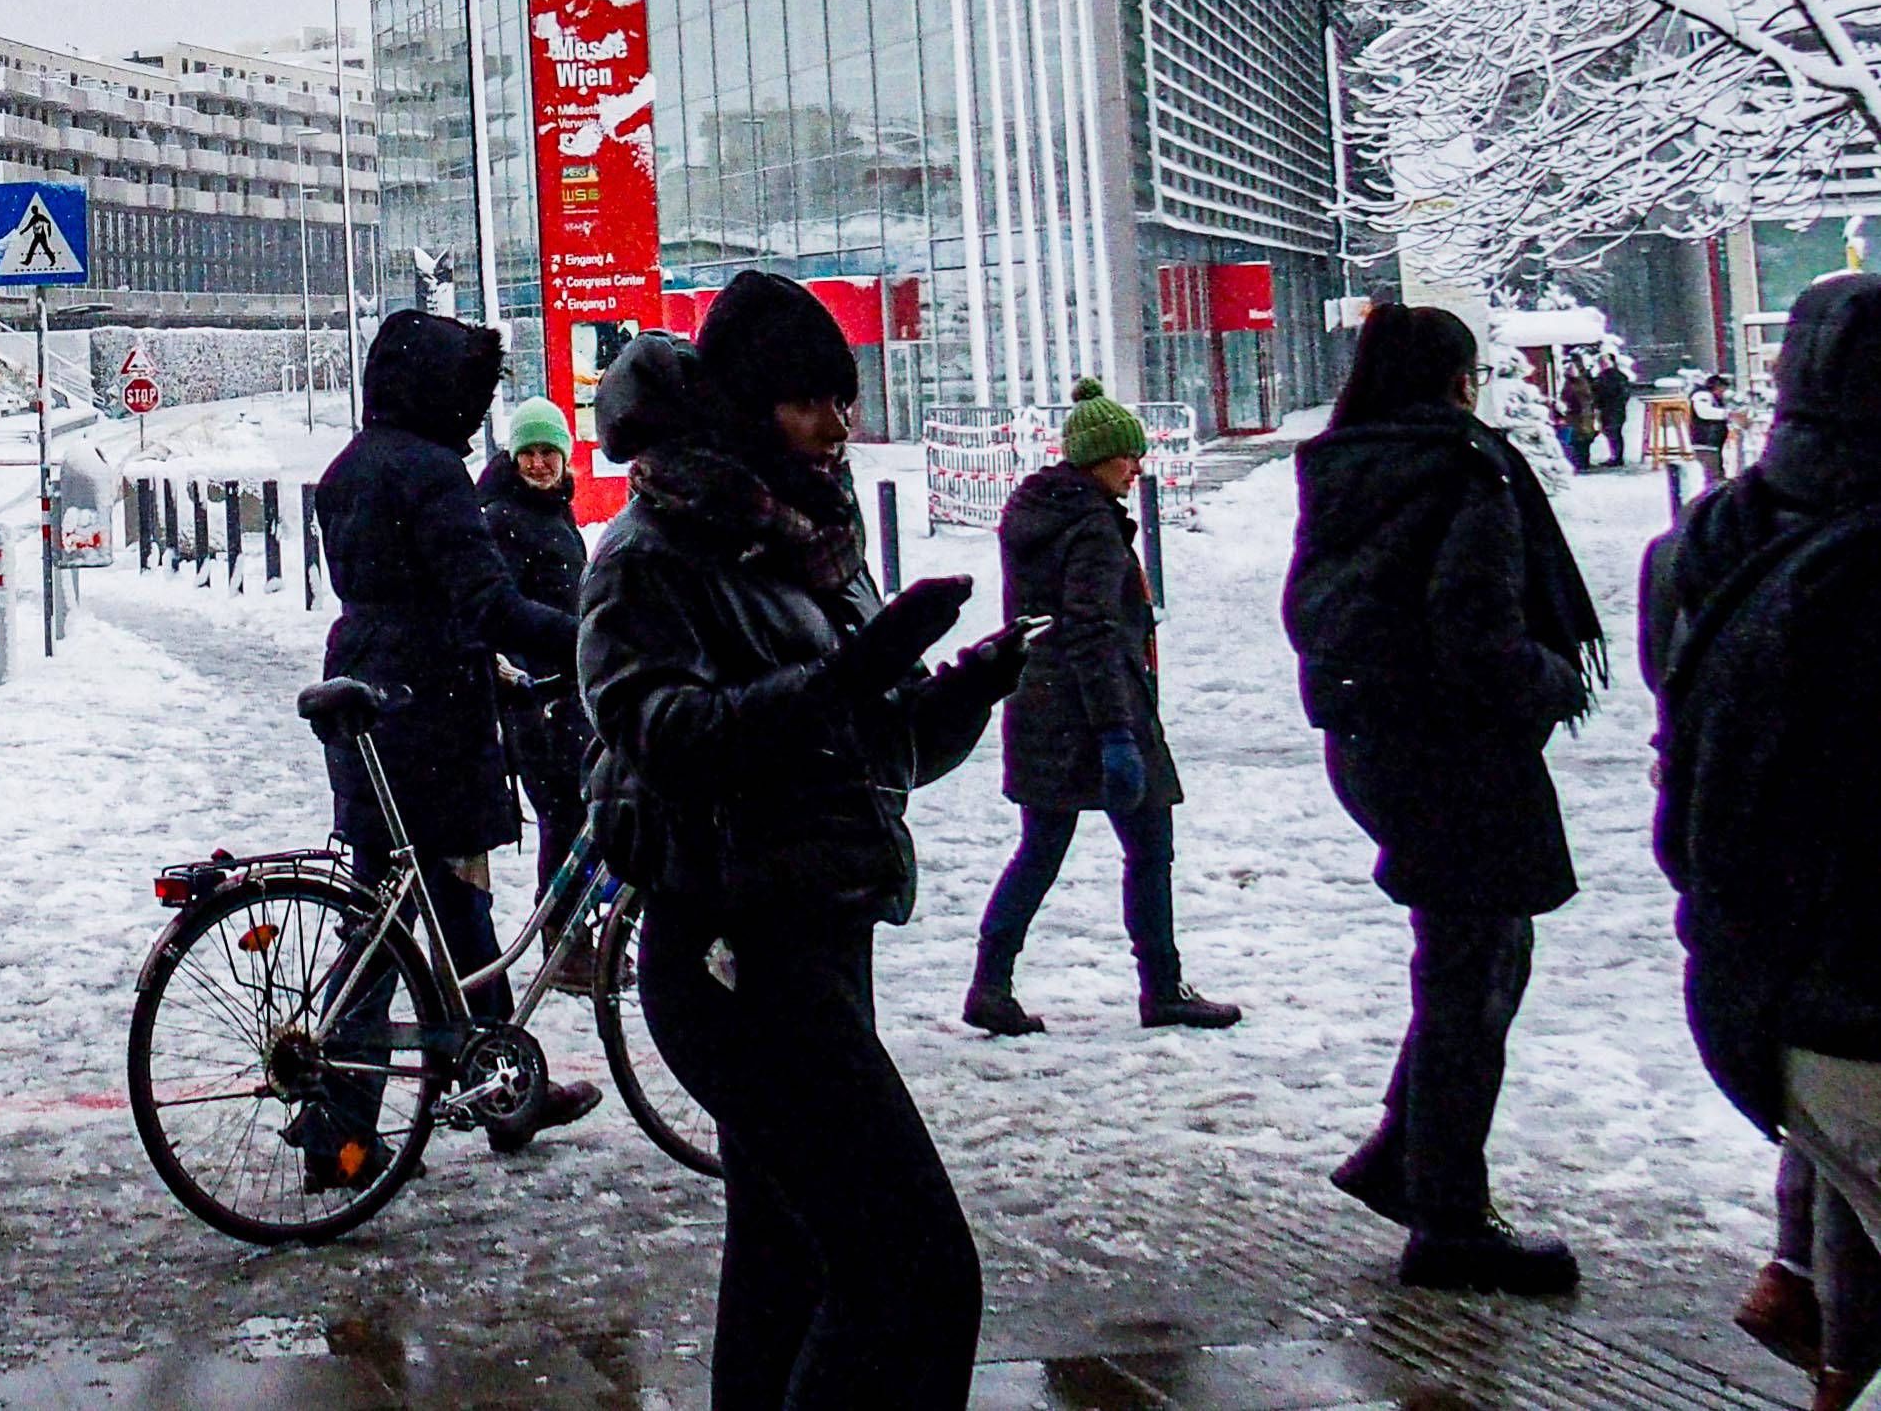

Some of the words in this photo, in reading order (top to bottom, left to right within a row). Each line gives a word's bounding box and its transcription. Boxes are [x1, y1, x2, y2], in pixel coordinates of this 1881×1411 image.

[556, 62, 613, 87] Wien
[565, 254, 604, 267] Eingang
[605, 252, 614, 264] A
[566, 276, 612, 289] Congress
[614, 274, 646, 286] Center
[567, 298, 606, 311] Eingang
[608, 297, 617, 309] D
[127, 387, 156, 404] STOP
